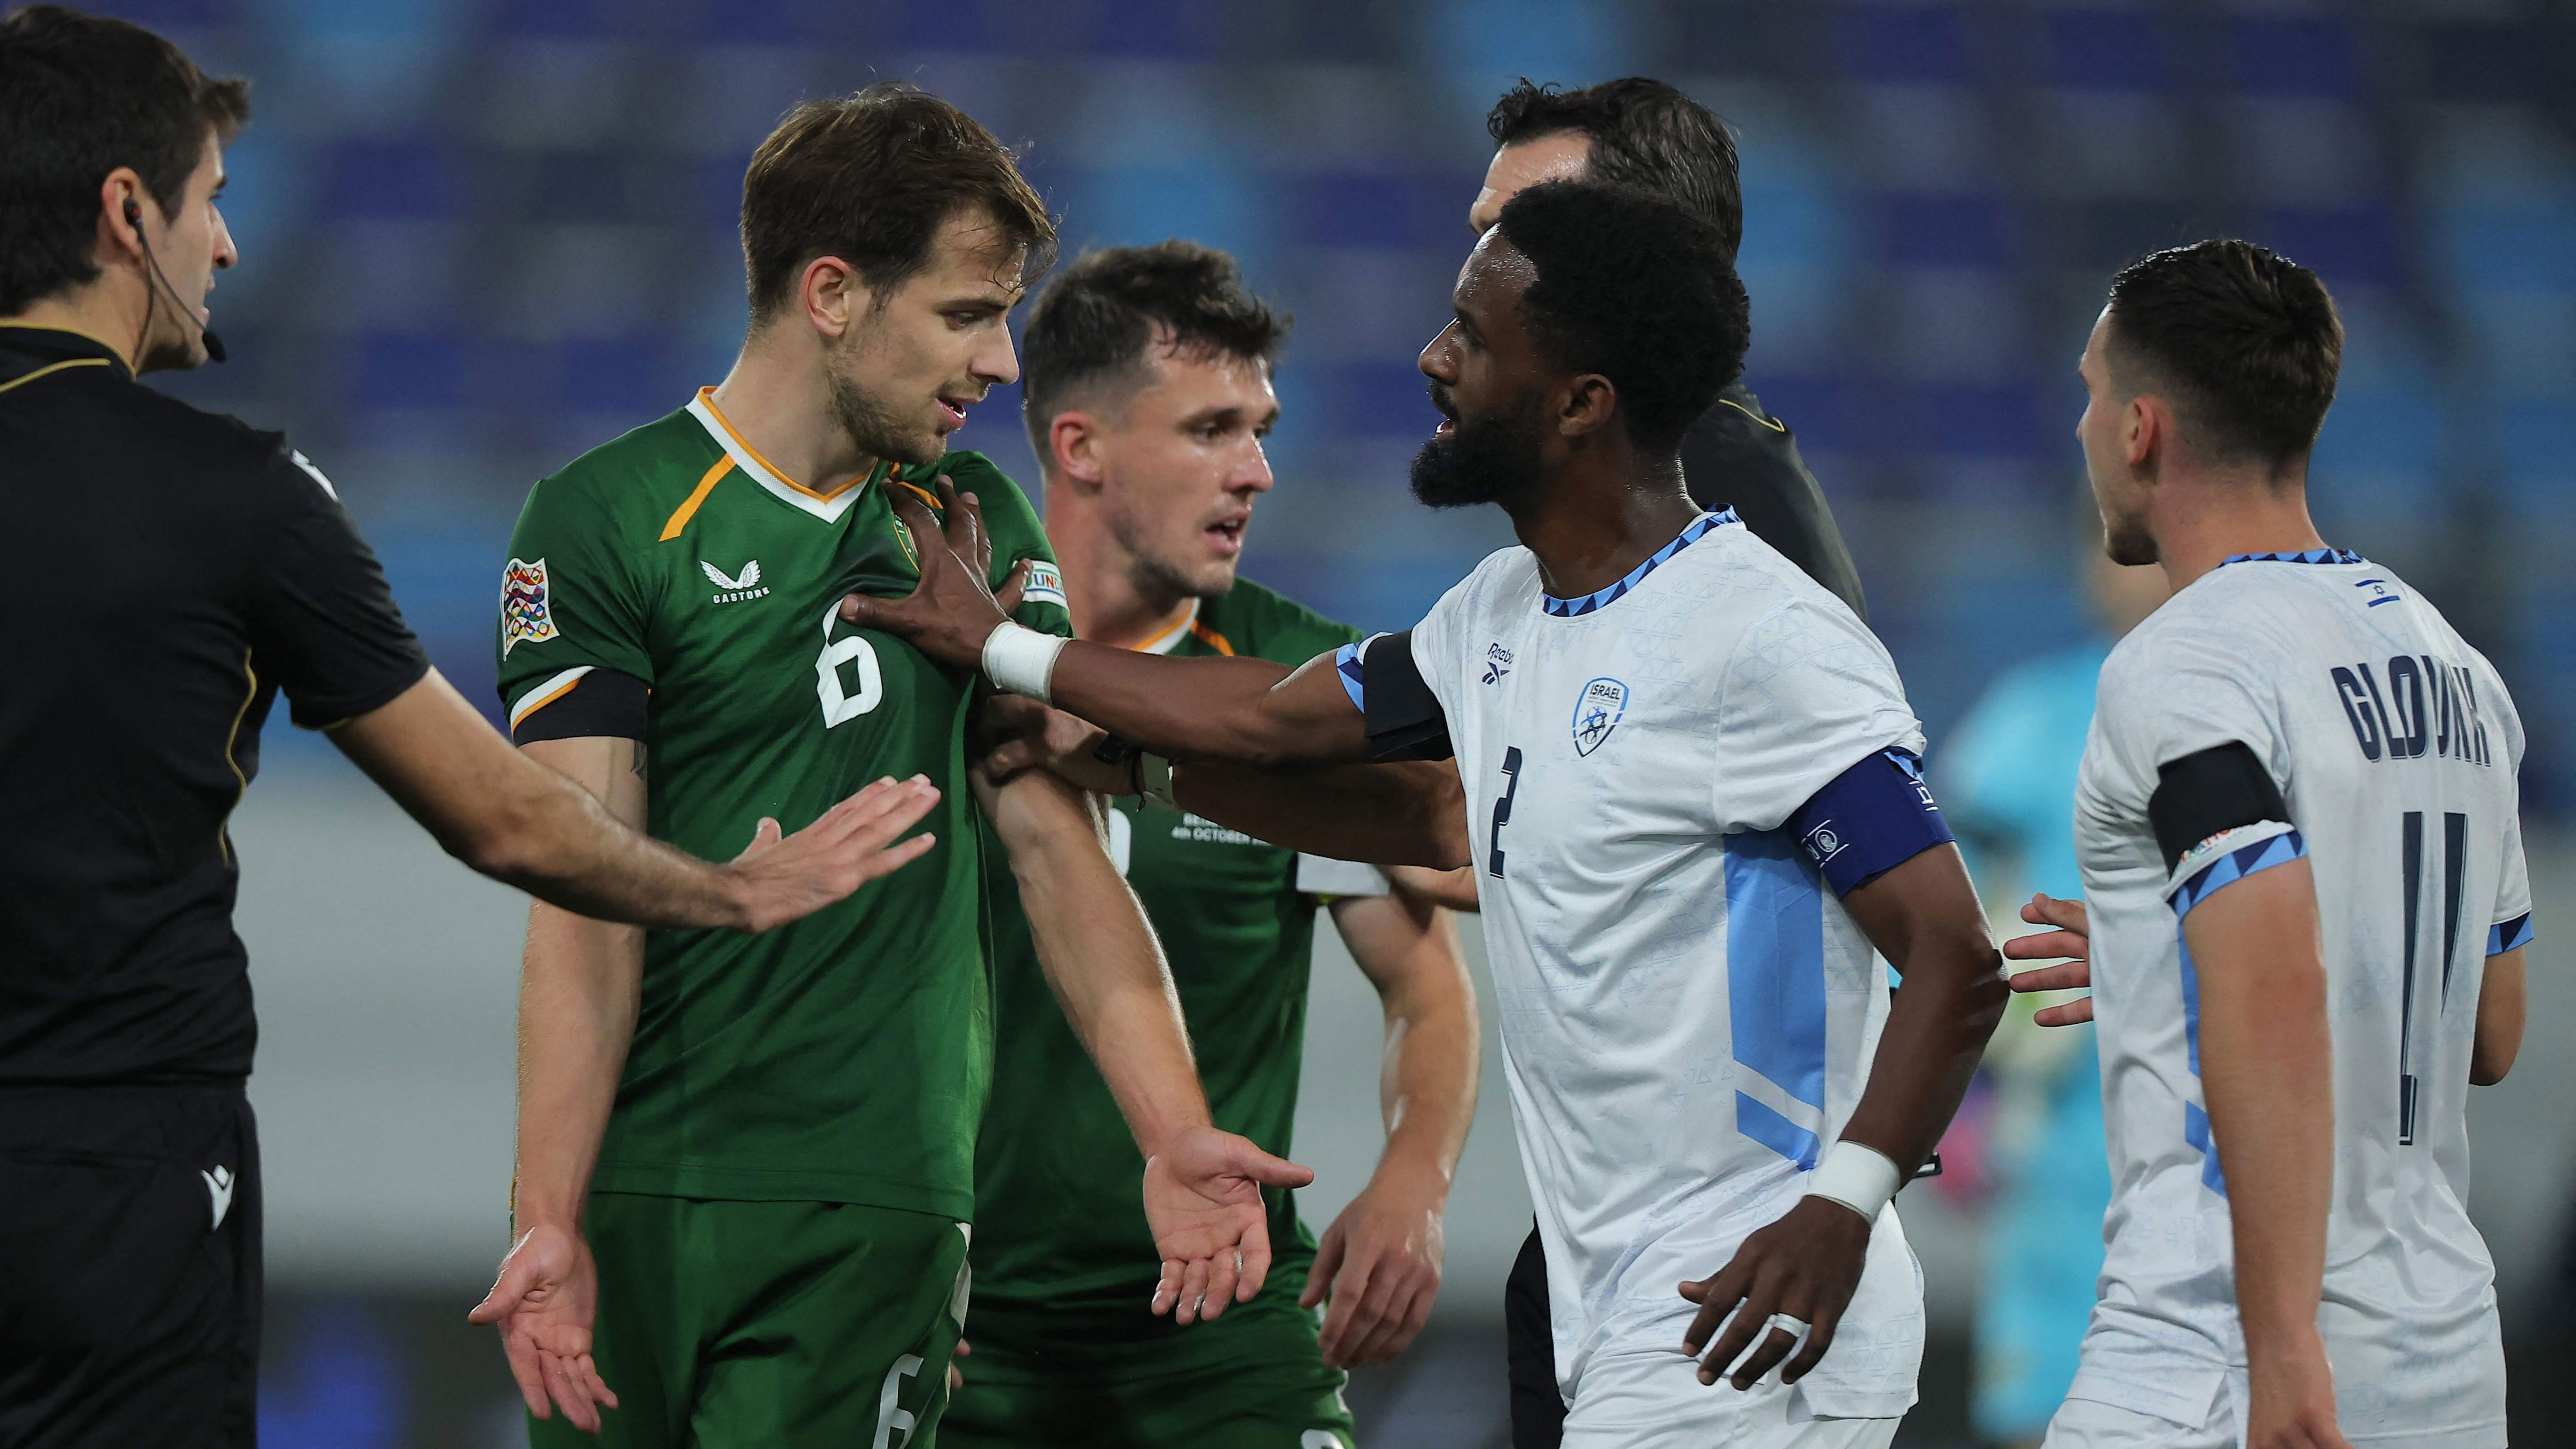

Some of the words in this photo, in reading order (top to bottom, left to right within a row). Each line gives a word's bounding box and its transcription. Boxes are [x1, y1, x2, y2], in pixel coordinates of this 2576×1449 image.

[713, 587, 771, 604] CASTORE
[815, 598, 883, 730] 6
[1589, 684, 1620, 700] ISRAEL
[1489, 746, 1522, 880] 2
[872, 1353, 924, 1449] 6
